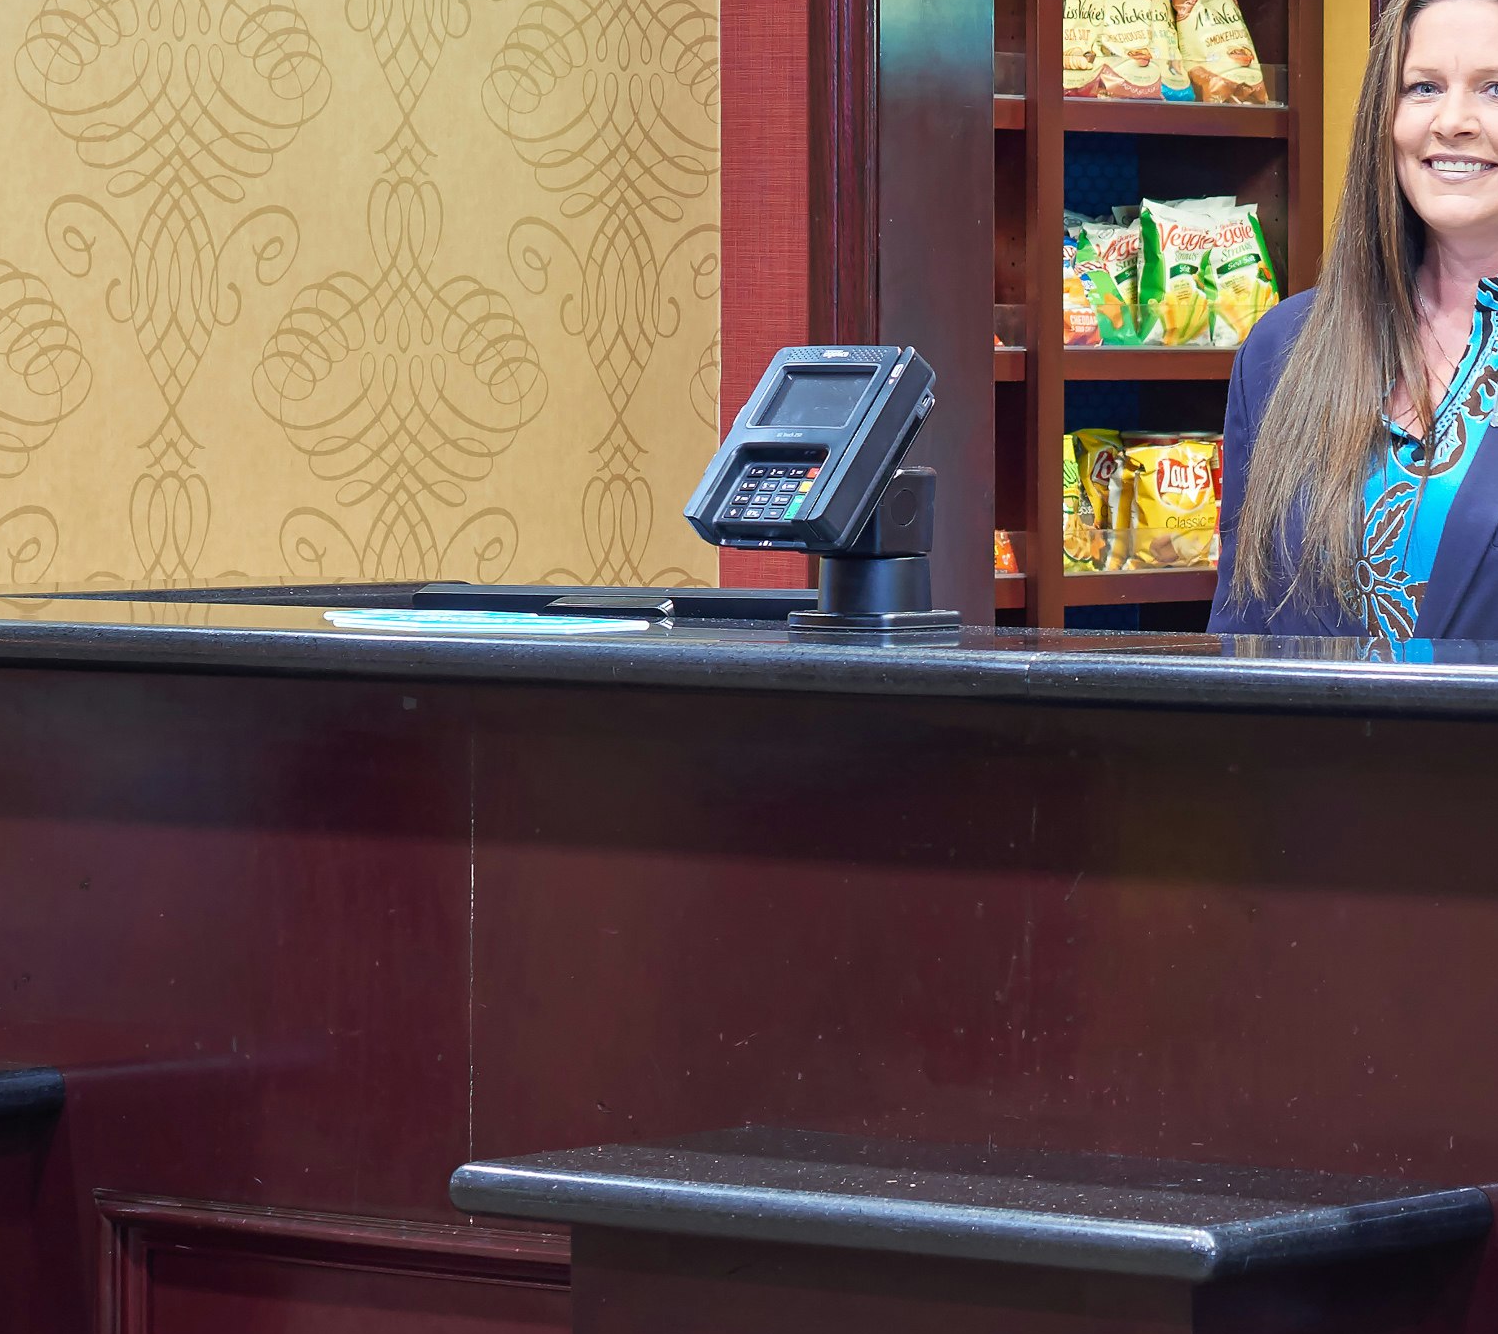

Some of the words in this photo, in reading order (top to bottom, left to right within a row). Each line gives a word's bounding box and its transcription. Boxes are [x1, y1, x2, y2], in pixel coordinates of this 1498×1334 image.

[1159, 222, 1215, 251] Veggie
[1214, 220, 1254, 248] eggie
[1160, 458, 1208, 504] Lay's
[1166, 516, 1207, 529] Classic
